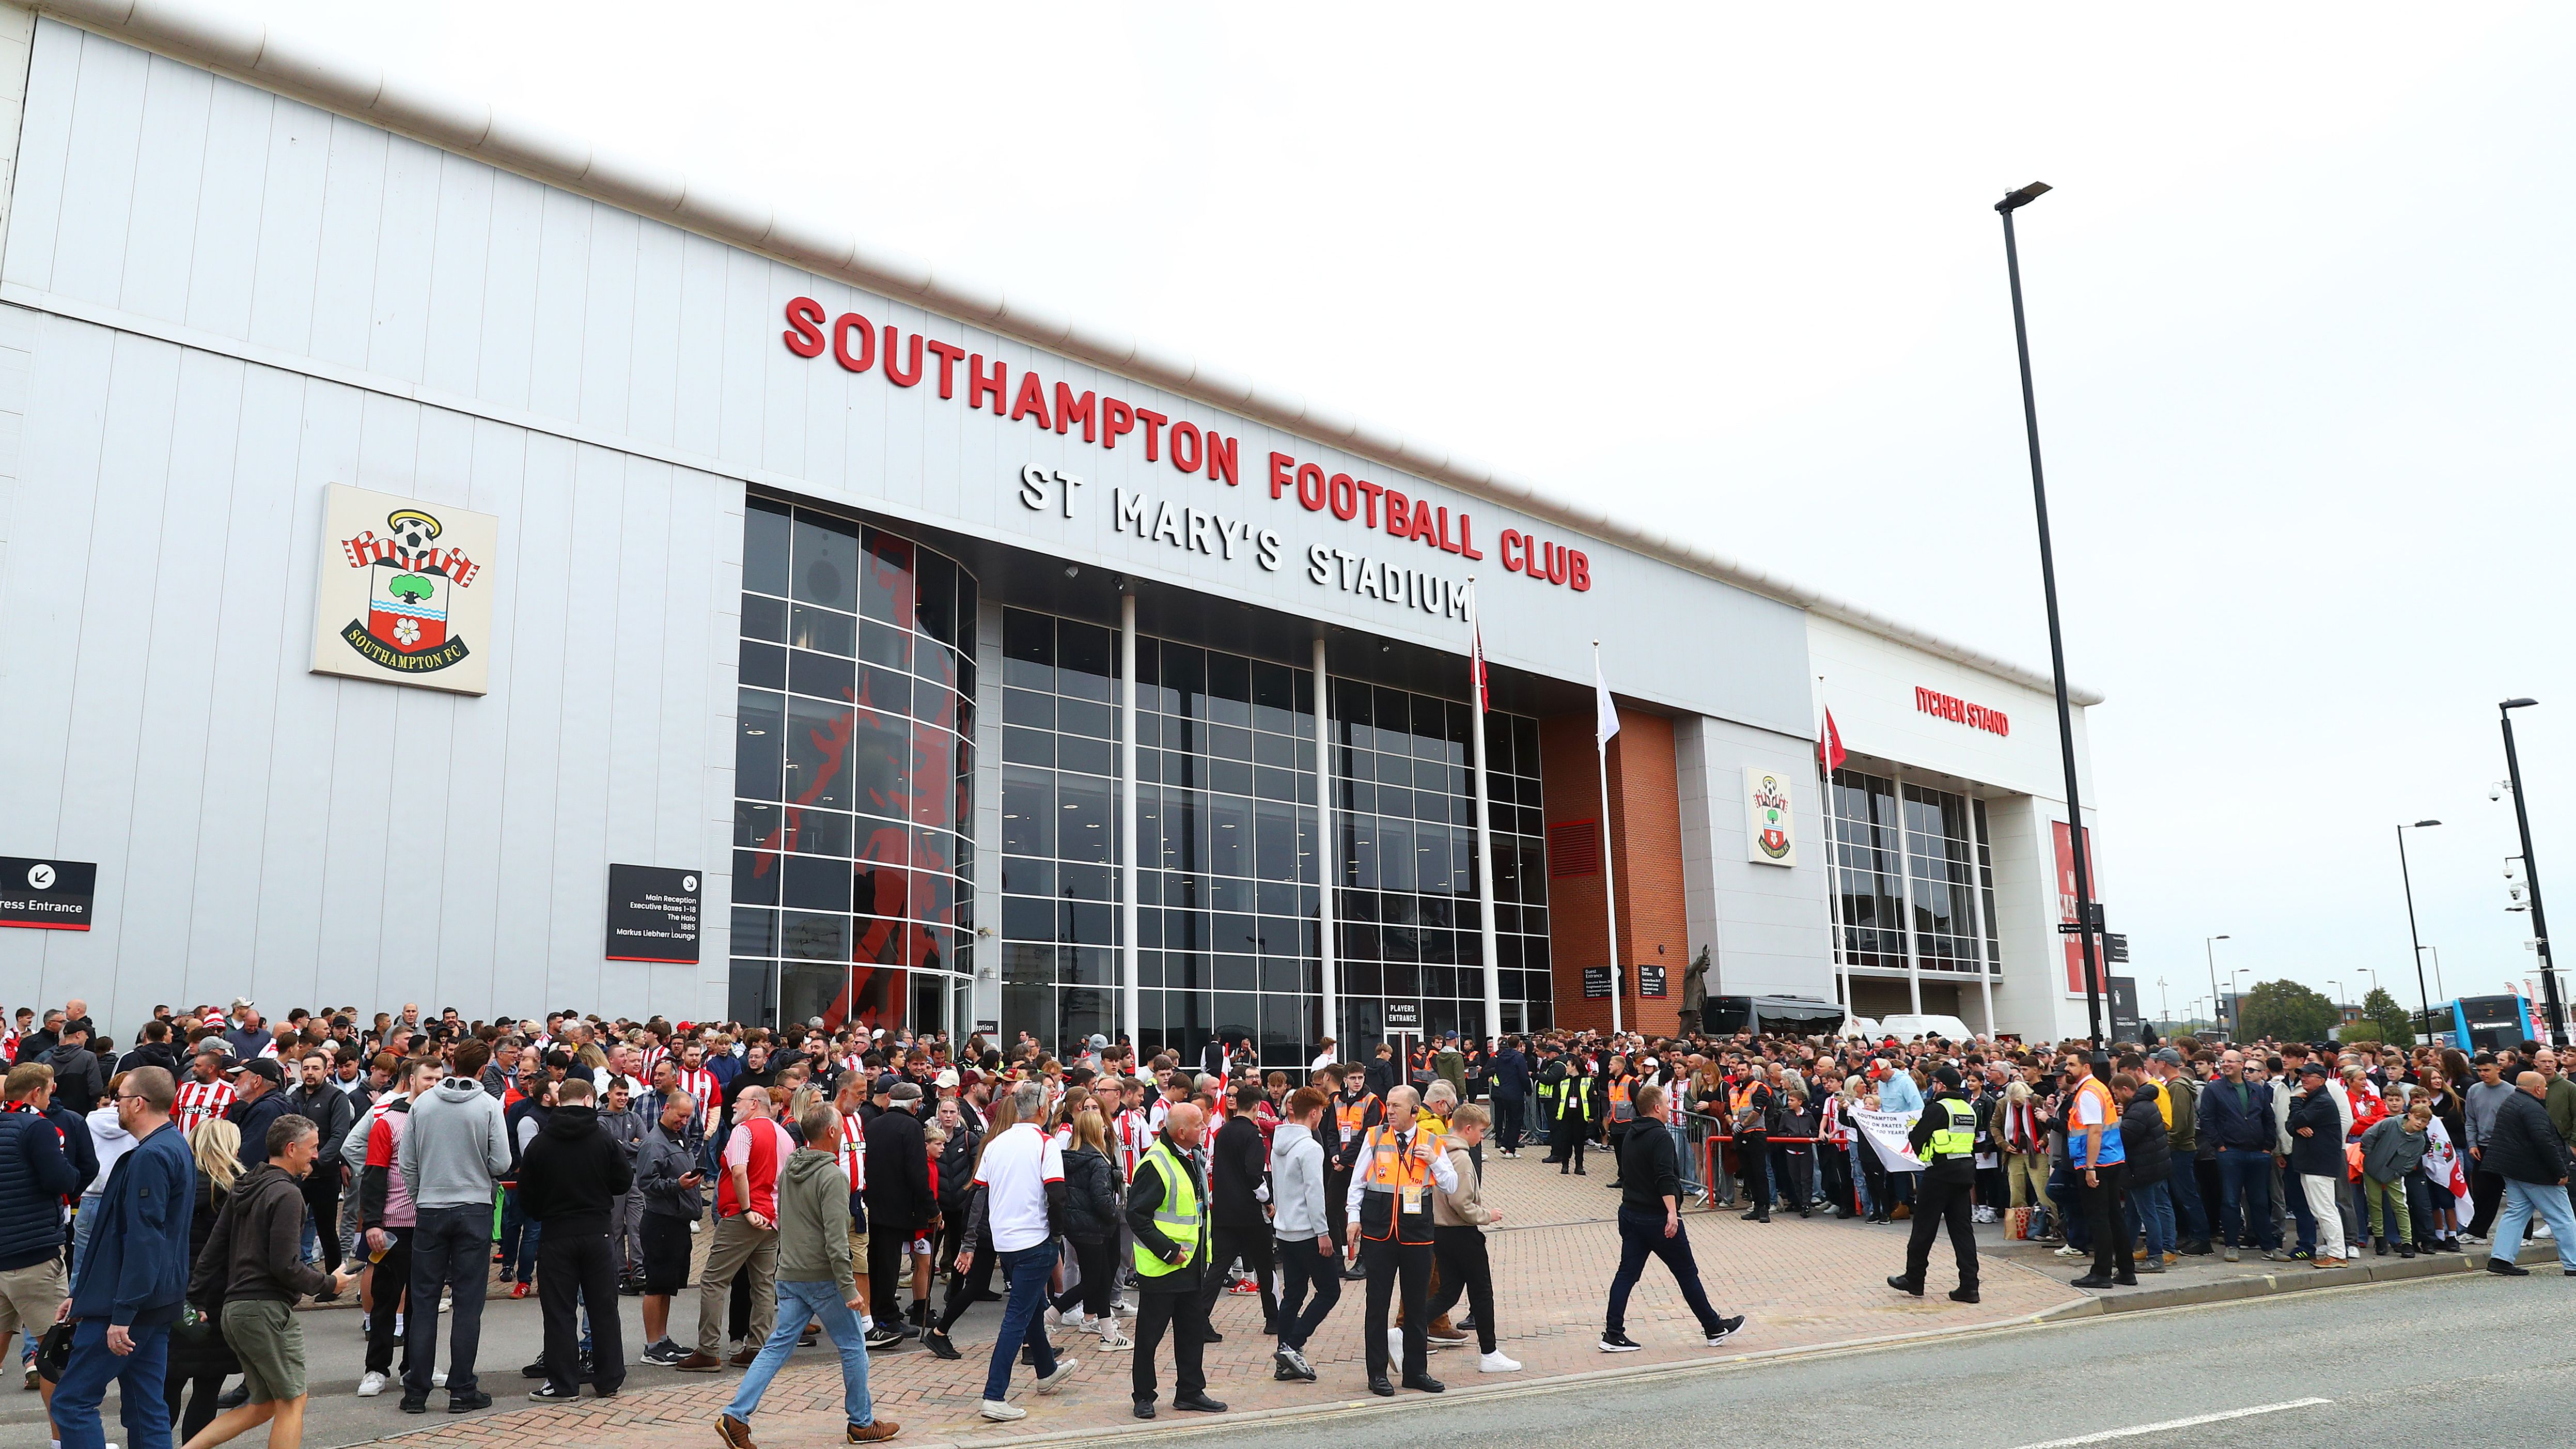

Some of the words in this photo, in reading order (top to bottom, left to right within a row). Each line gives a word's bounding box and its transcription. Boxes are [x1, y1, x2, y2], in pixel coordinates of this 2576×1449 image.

[783, 296, 1239, 486] SOUTHAMPTON
[1269, 451, 1484, 561] FOOTBALL
[1501, 528, 1591, 592] CLUB
[1020, 463, 1083, 519] ST
[1115, 487, 1283, 571] MARY'S
[1308, 542, 1471, 621] STADIUM
[348, 629, 443, 669] SOUTHAMPTON
[443, 644, 461, 662] FC
[1915, 686, 1966, 724] ITCHEN
[1967, 703, 2009, 737] STAND
[28, 900, 83, 913] Entrance
[630, 901, 662, 911] Executive
[663, 904, 682, 912] Boxes
[645, 894, 663, 902] Main
[663, 895, 697, 906] Reception
[616, 928, 642, 937] Markus
[643, 929, 670, 938] Liebherr
[671, 930, 695, 941] Lounge
[183, 1105, 212, 1115] veho
[1857, 1112, 1897, 1121] SOUTHAMPTON
